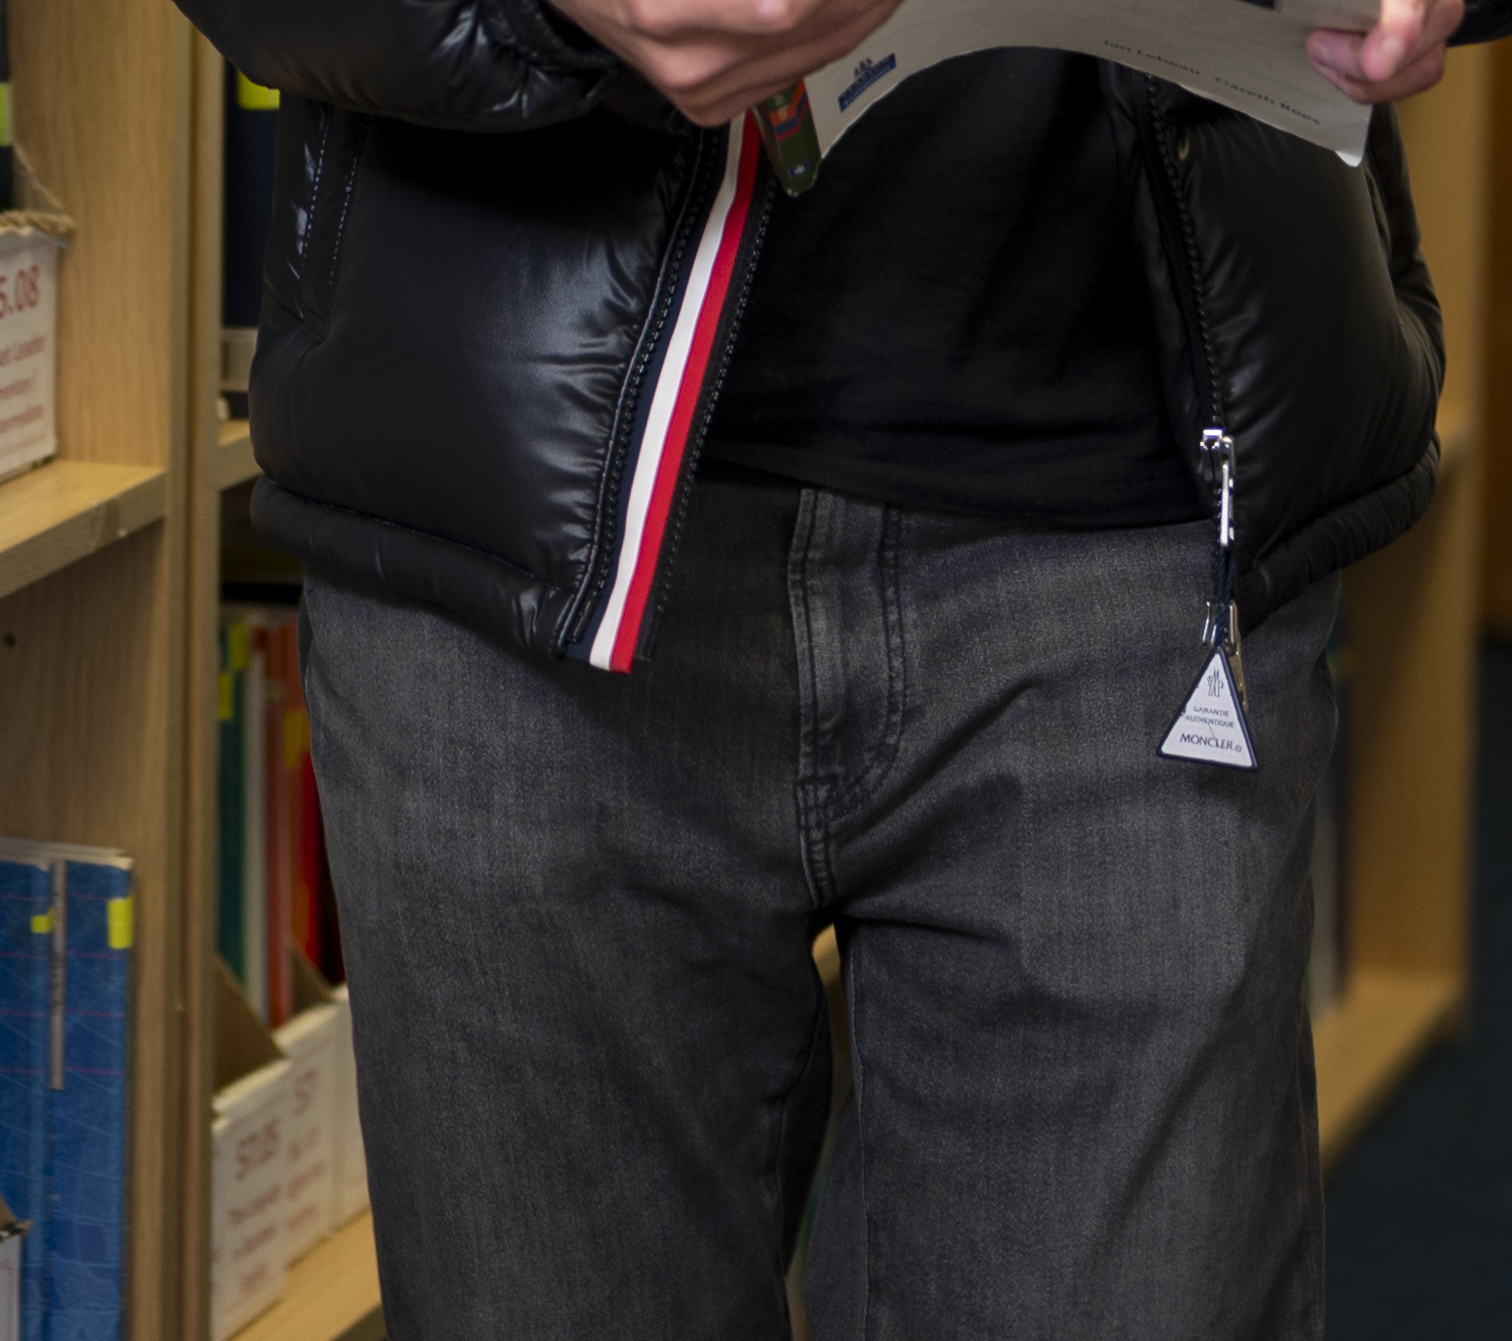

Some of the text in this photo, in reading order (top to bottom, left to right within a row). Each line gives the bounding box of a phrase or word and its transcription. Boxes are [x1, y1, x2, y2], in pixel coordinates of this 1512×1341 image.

[1215, 76, 1276, 106] Gareth
[1279, 101, 1321, 127] Rees
[1193, 705, 1230, 718] GARANTIE
[1185, 715, 1234, 729] AUTHENTIQUE
[1179, 732, 1233, 750] MONCLER
